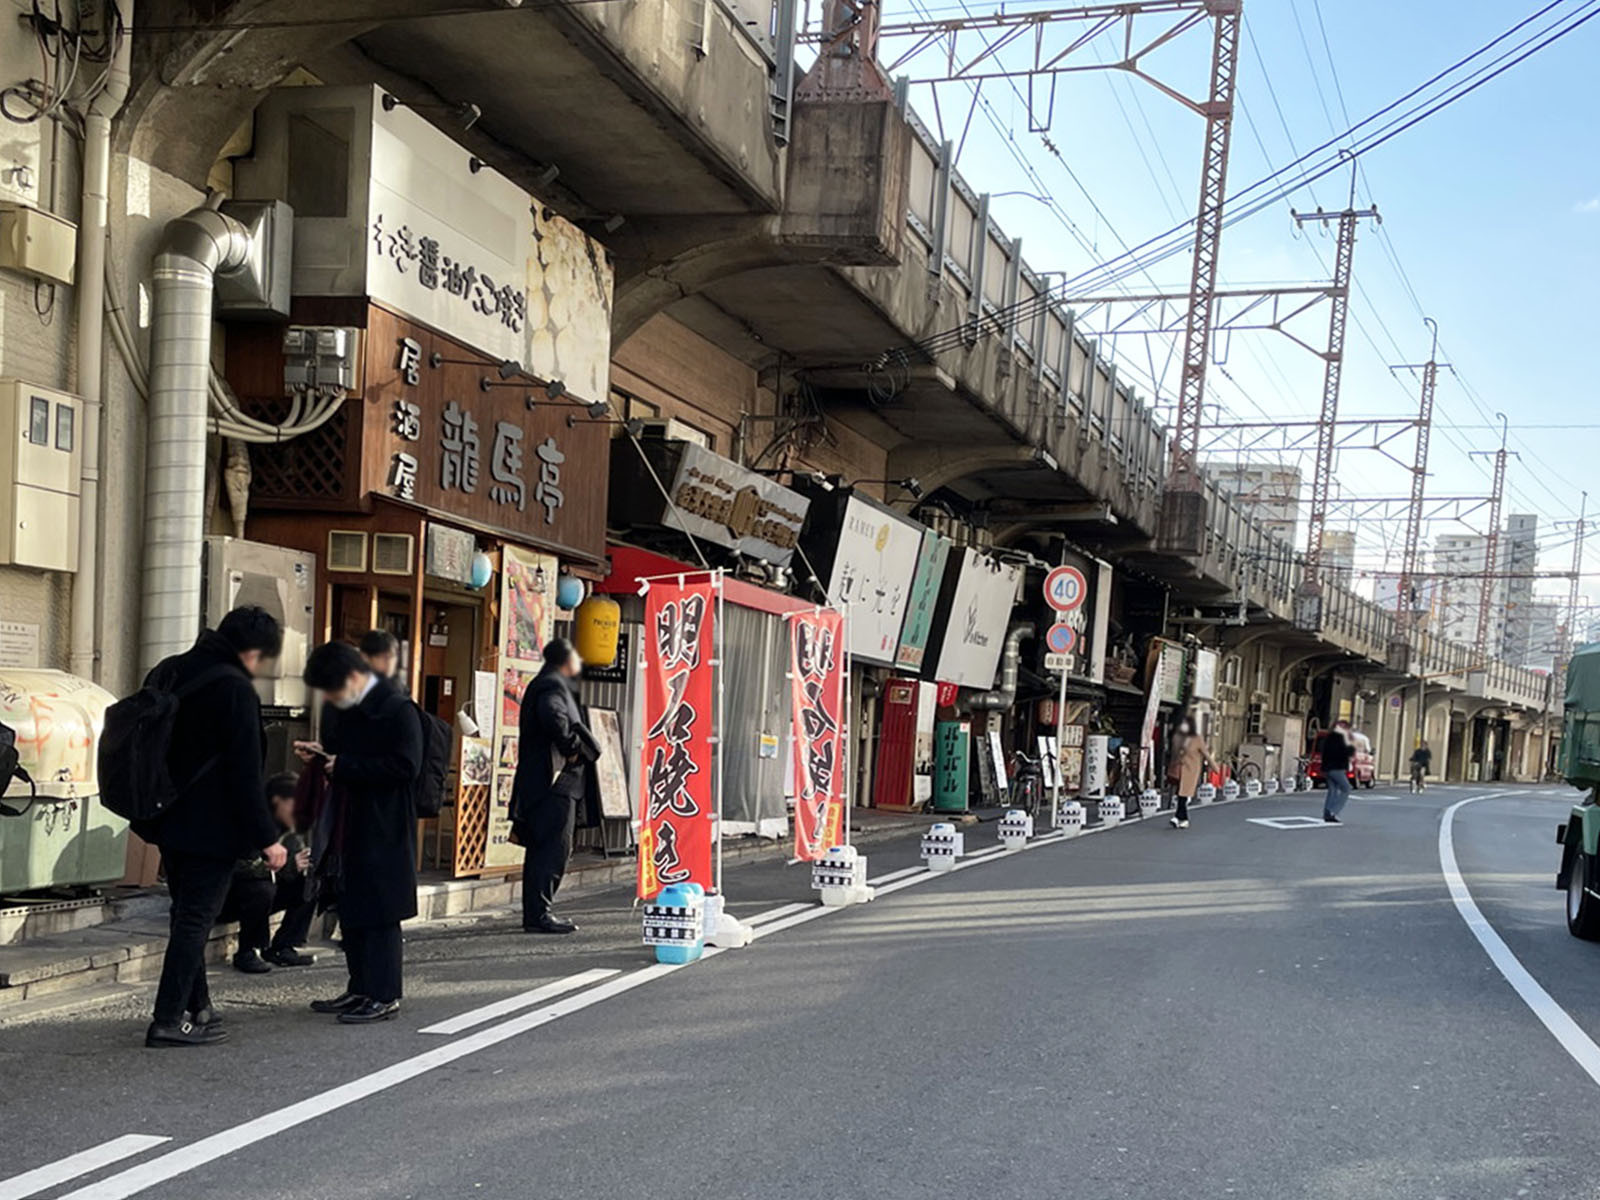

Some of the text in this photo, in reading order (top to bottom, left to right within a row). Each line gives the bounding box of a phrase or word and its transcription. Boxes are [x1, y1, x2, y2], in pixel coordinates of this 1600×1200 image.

[395, 337, 421, 499] 居酒屋
[441, 401, 566, 523] 龍馬亭
[1054, 579, 1077, 600] 40
[648, 593, 705, 882] 明石焼き
